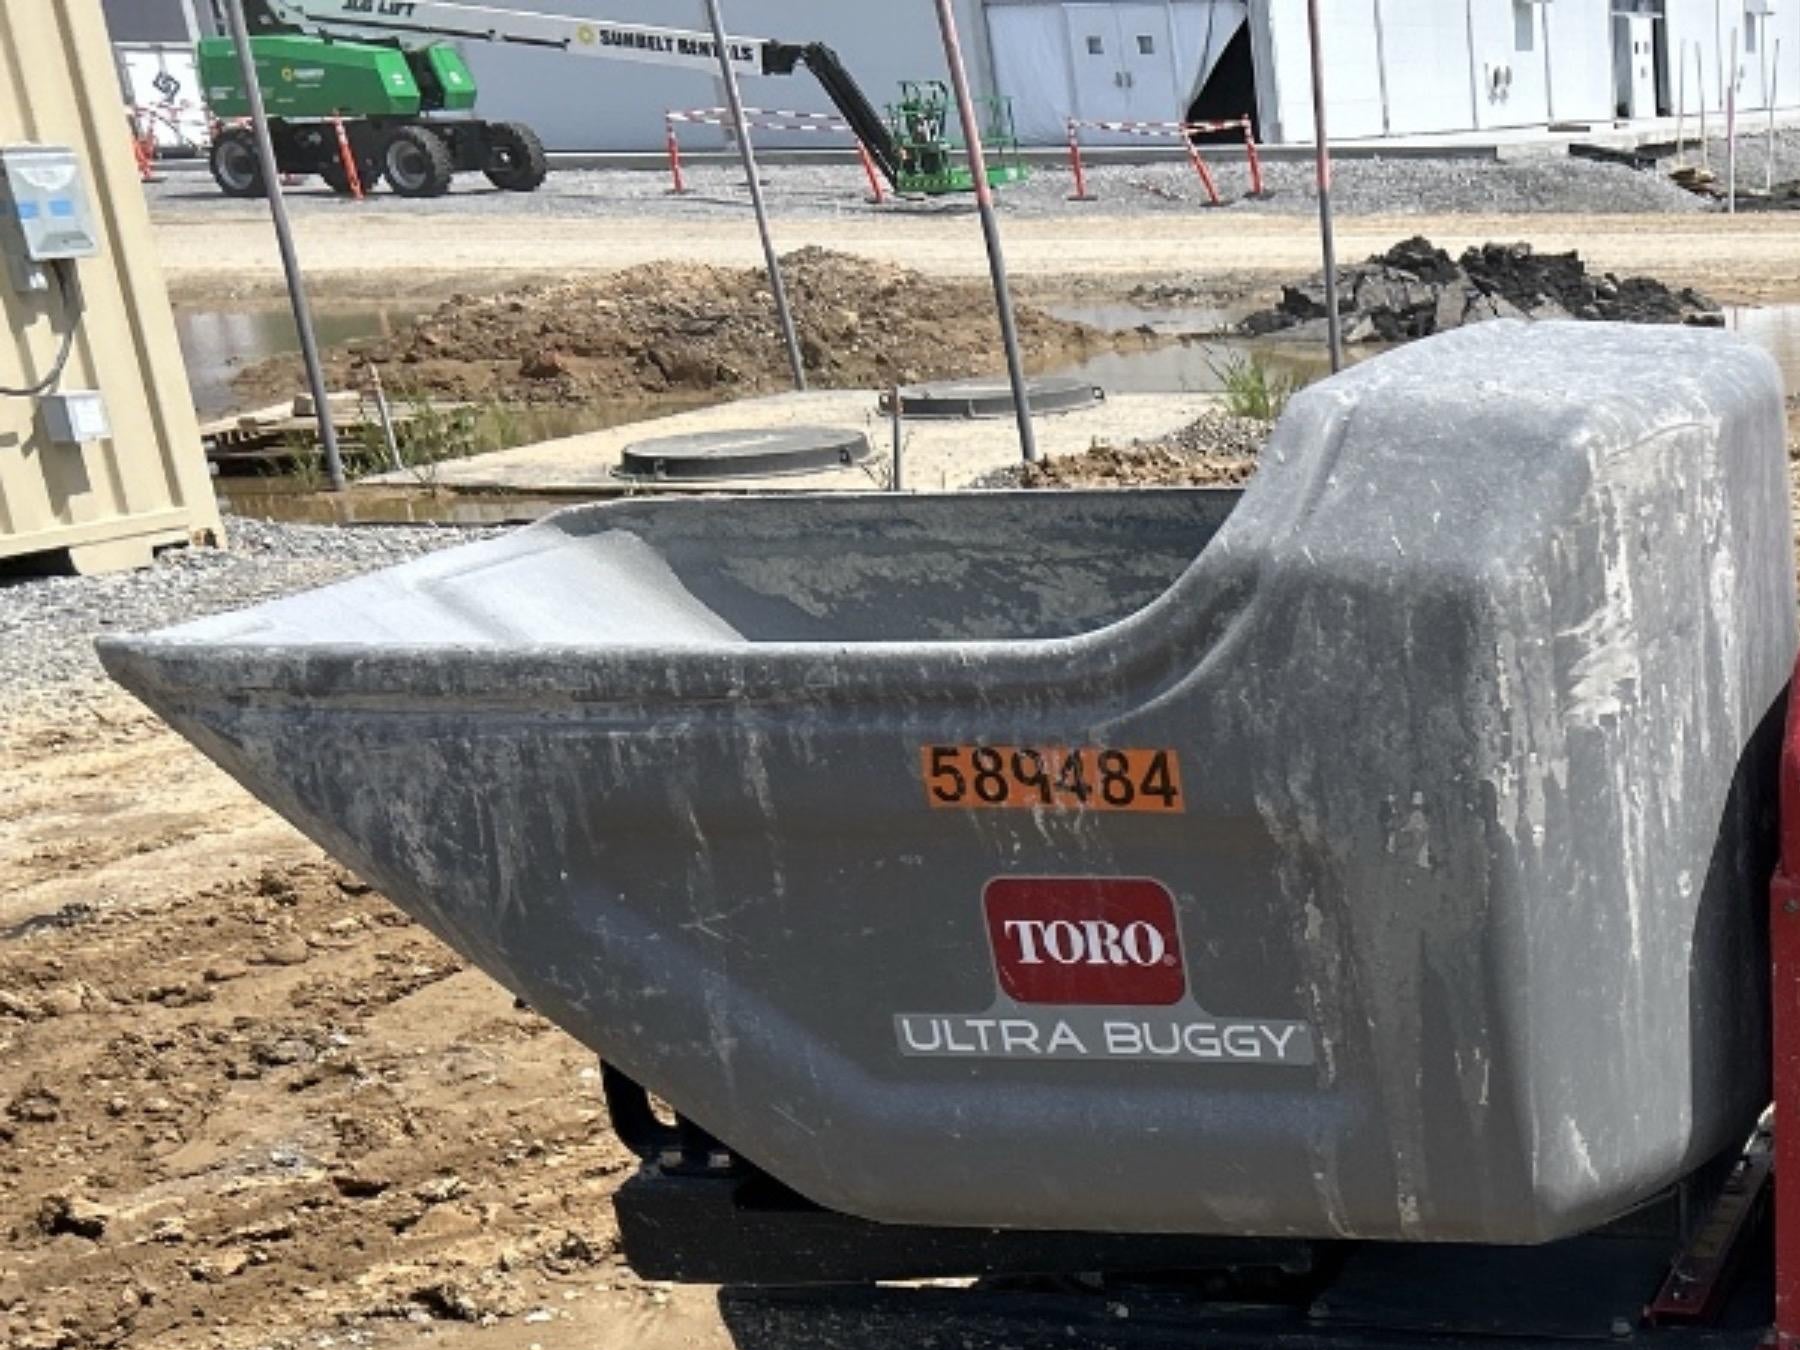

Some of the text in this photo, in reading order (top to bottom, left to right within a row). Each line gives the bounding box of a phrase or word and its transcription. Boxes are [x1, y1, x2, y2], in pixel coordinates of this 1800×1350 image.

[678, 38, 753, 61] RENTLS
[931, 746, 1176, 807] 589484
[1005, 920, 1165, 966] TORO
[903, 1019, 1297, 1057] ULTRA BUGGY
